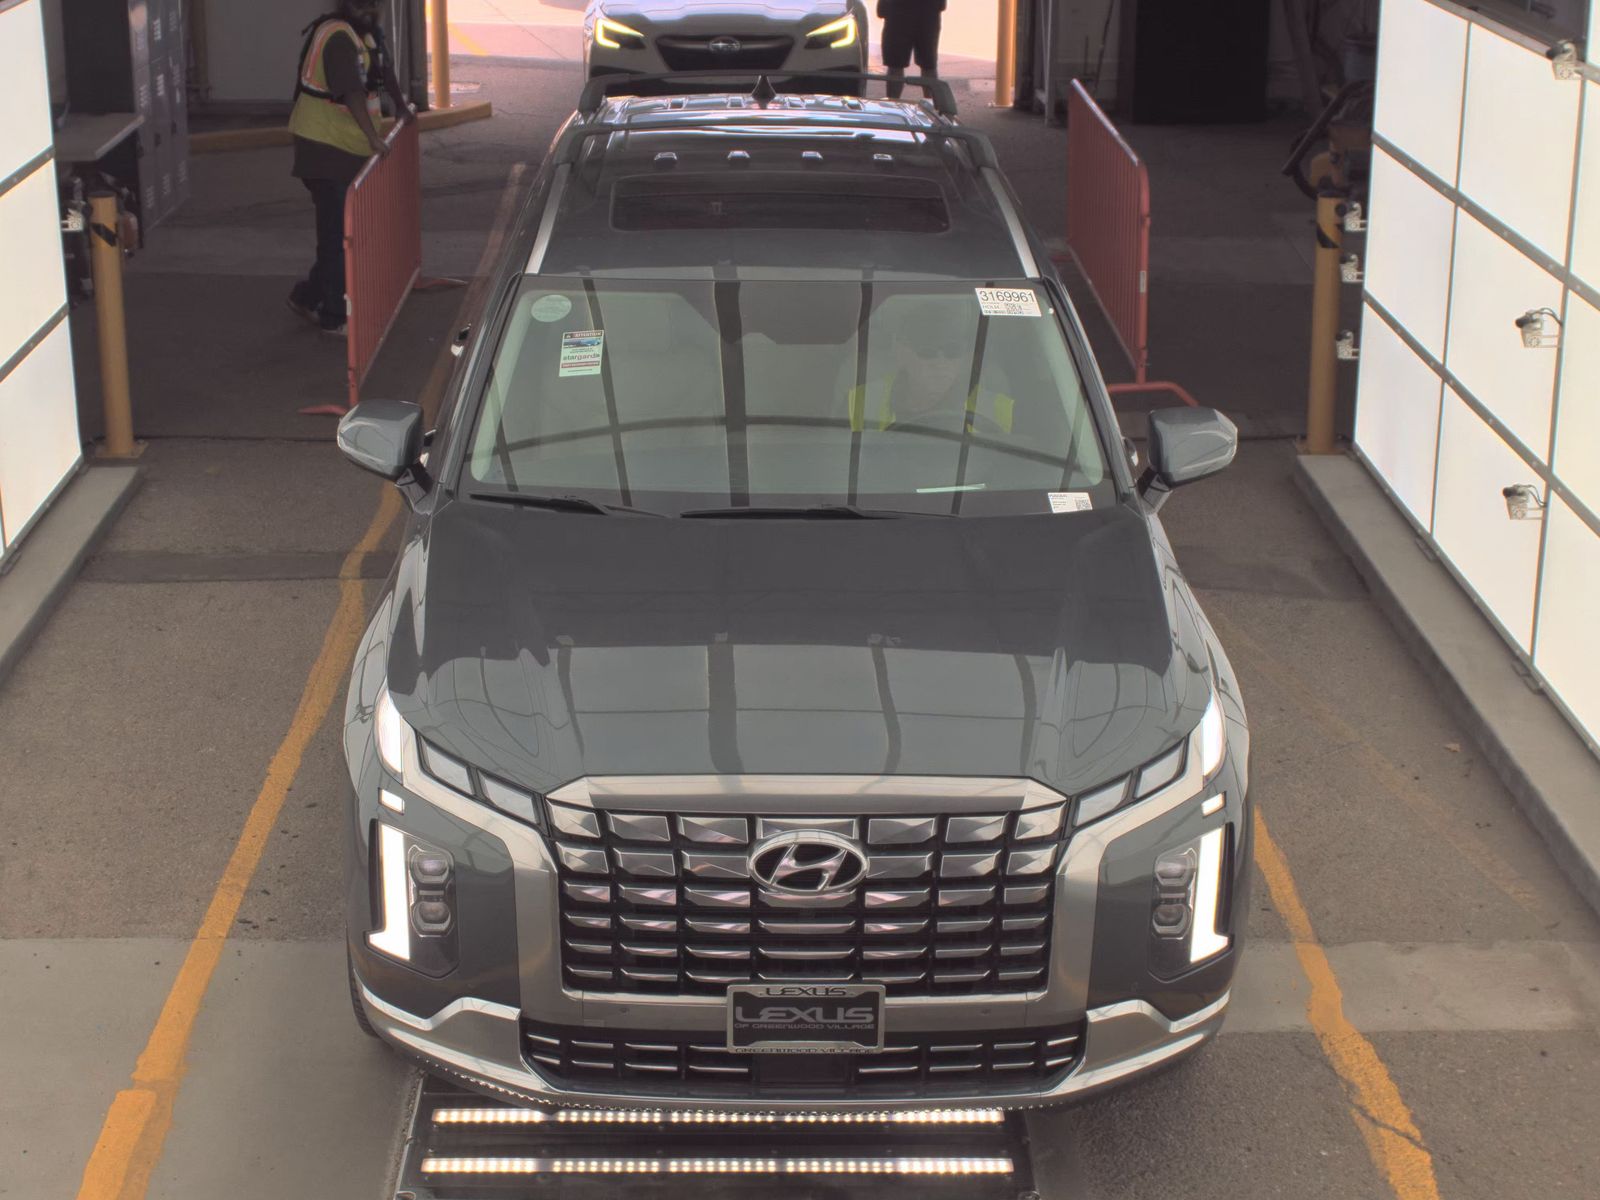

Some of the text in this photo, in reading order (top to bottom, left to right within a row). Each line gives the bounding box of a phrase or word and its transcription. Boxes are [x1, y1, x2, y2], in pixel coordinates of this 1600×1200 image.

[979, 290, 1035, 303] 3169961
[766, 987, 847, 996] LEXUS
[735, 1006, 875, 1023] LEXUS
